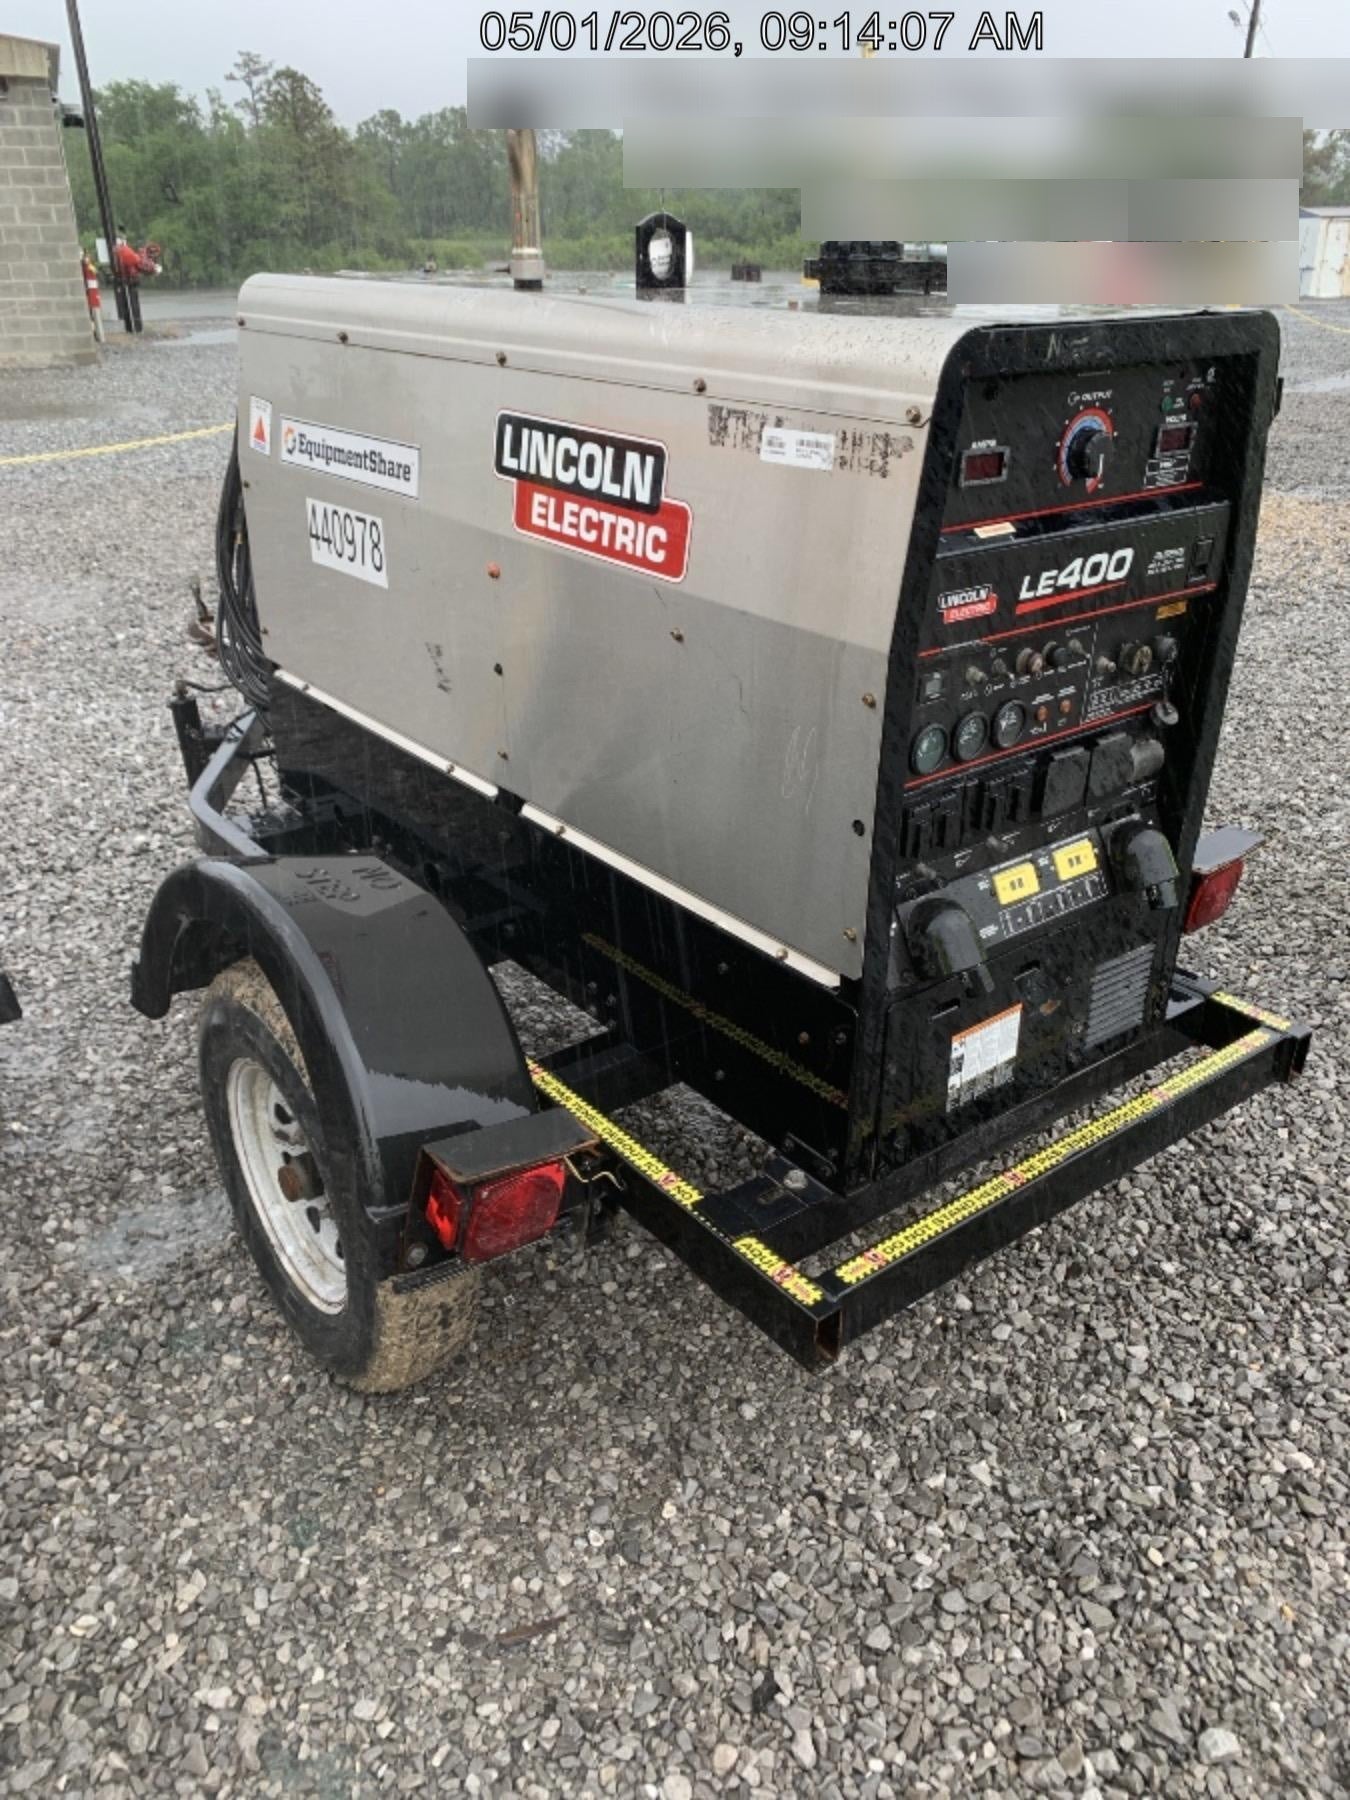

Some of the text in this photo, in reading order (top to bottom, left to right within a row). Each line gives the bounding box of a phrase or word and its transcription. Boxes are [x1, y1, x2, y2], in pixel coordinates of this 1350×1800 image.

[298, 433, 412, 482] EquipmentShare
[502, 424, 655, 505] LINCOLN
[309, 503, 383, 573] 440978
[531, 492, 667, 563] ELECTRIC
[940, 587, 991, 608] LINCOLN
[1020, 547, 1134, 600] LE400
[880, 1238, 904, 1257] DO
